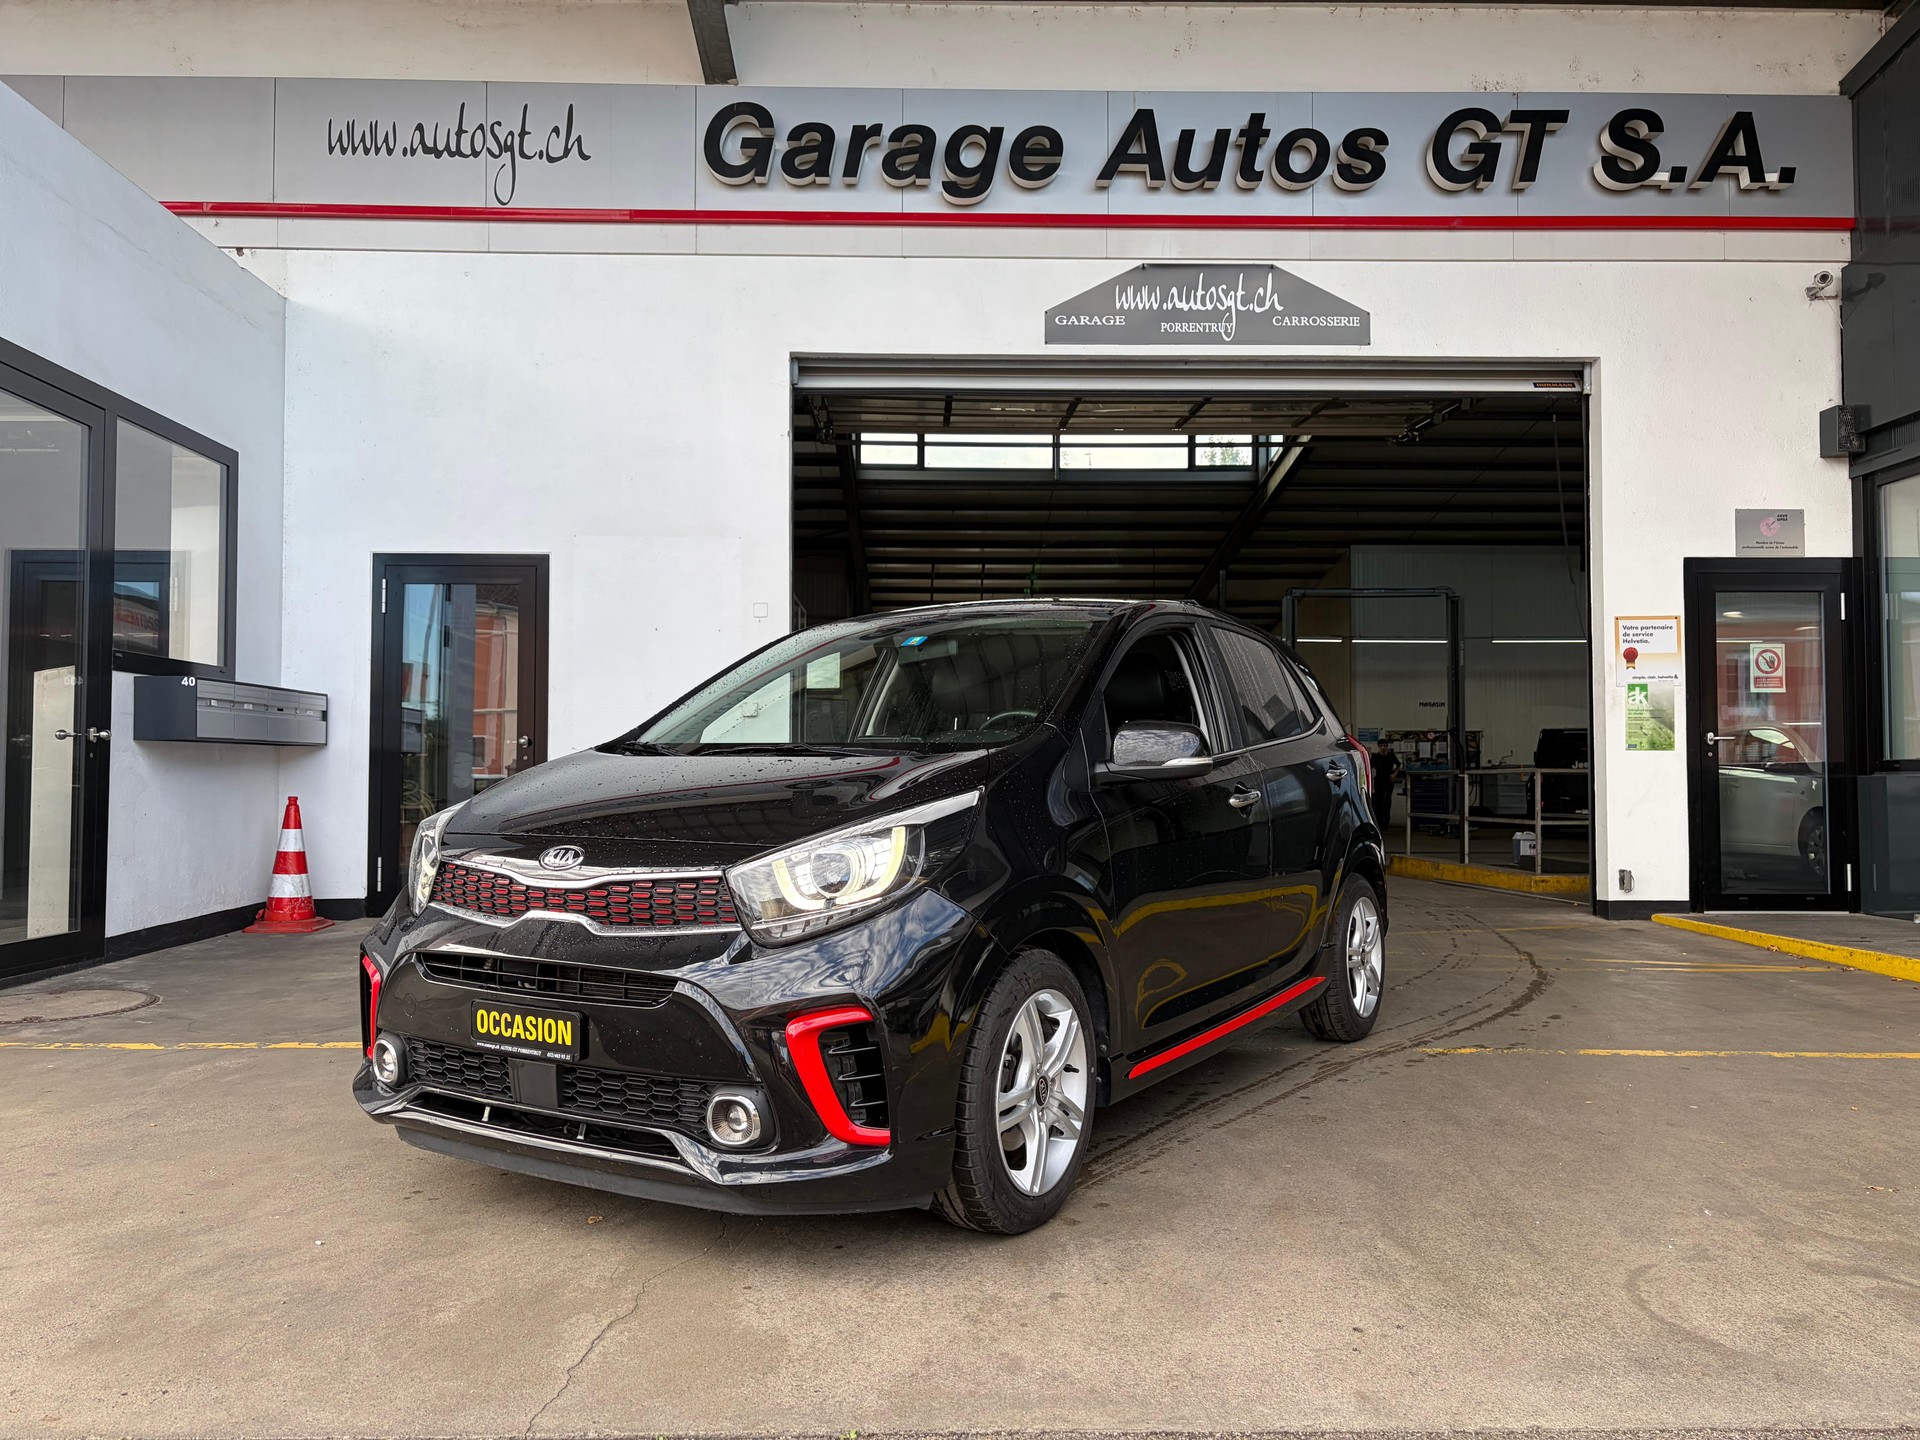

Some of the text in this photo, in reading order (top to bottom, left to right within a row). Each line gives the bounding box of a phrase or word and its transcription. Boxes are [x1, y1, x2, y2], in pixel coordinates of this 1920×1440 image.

[327, 101, 592, 206] www.autosgt.ch
[703, 101, 1797, 206] Garage Autos GT S.A.
[1115, 272, 1284, 341] www.autosgt.ch
[1055, 315, 1126, 326] GARAGE
[1160, 322, 1234, 333] PORRENTRUY
[1272, 315, 1360, 327] CARROSSERIE
[1640, 624, 1674, 632] partenaire
[181, 676, 196, 687] 40
[544, 849, 576, 865] KIA
[476, 1009, 572, 1046] OCCASION
